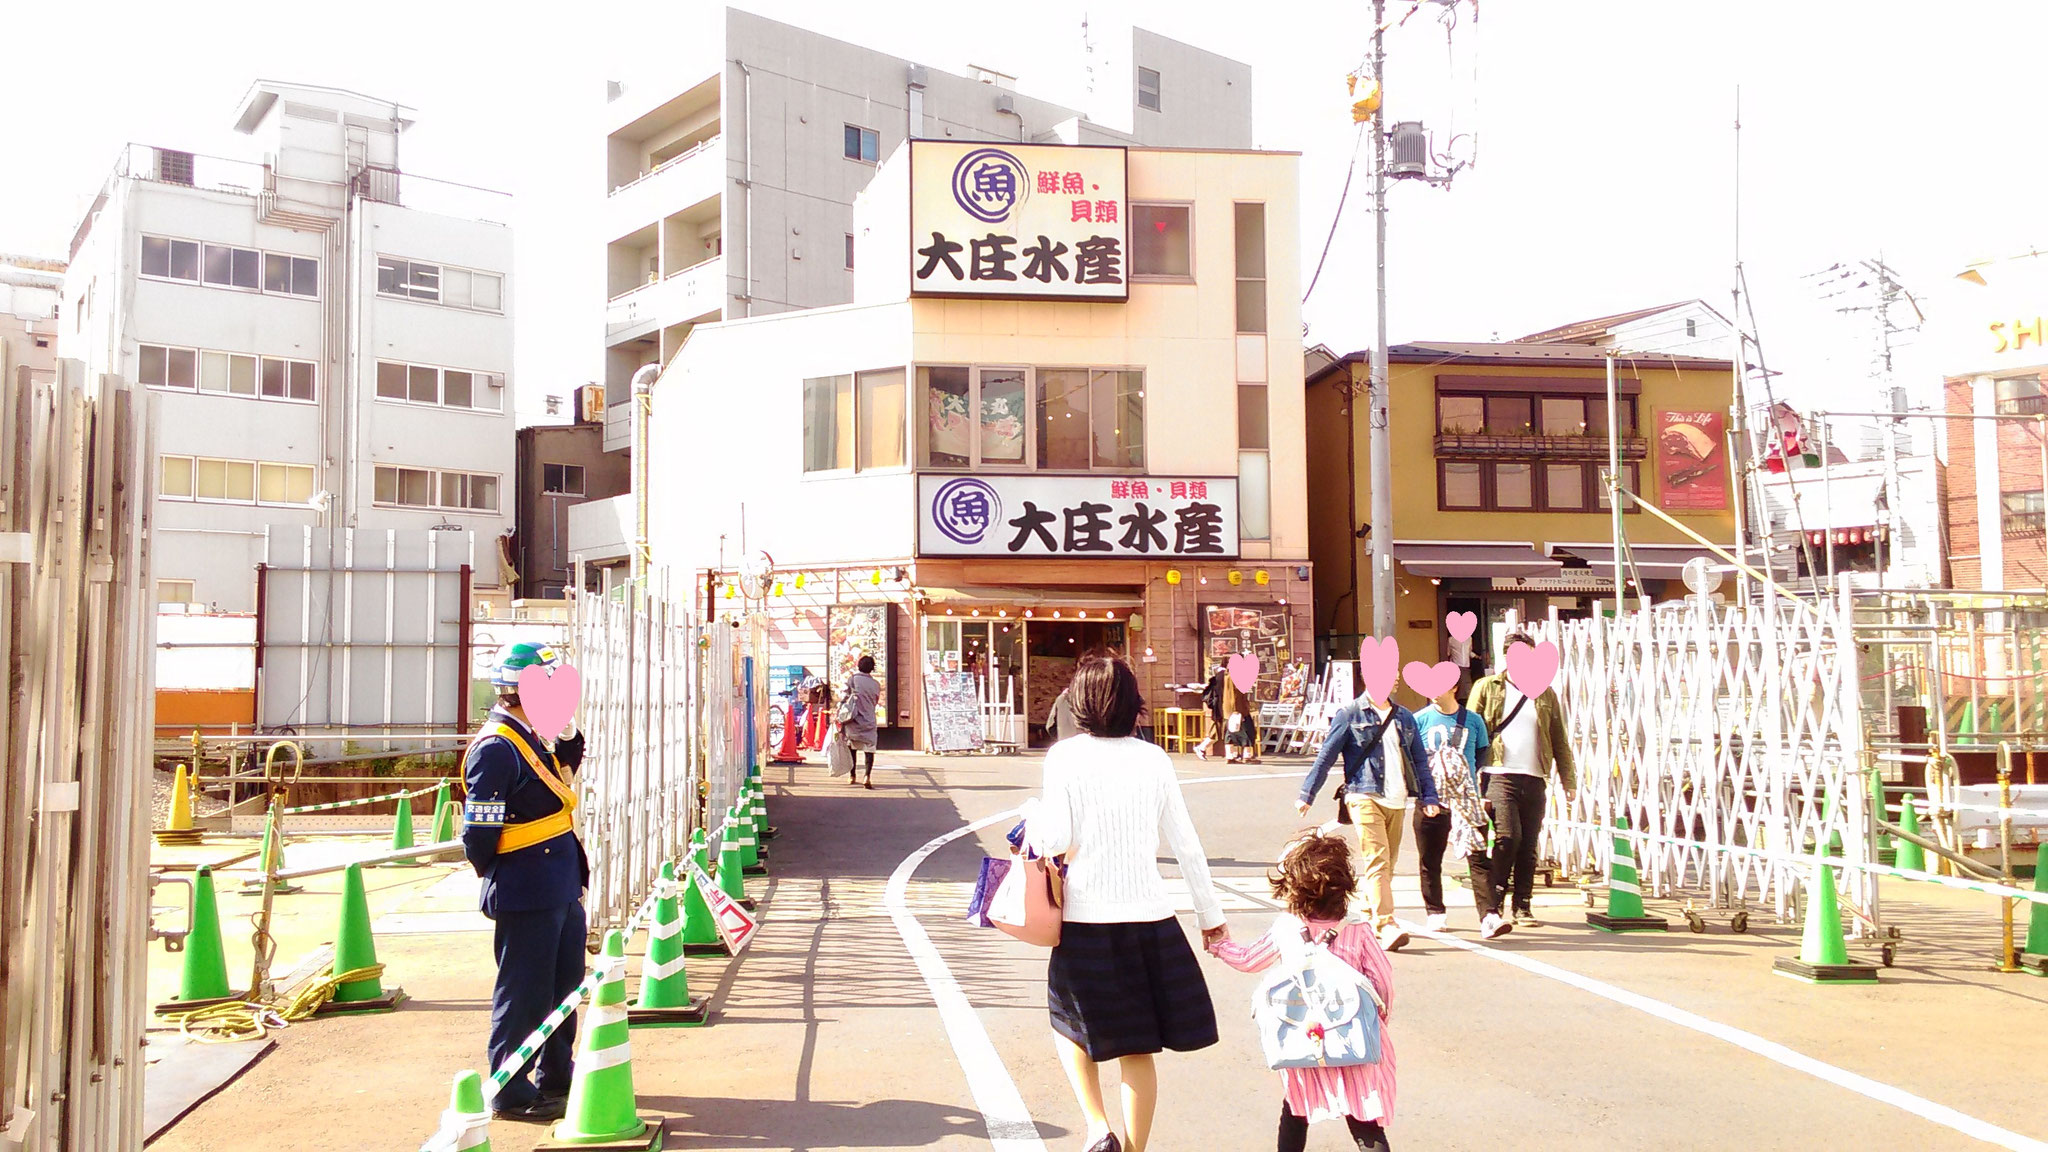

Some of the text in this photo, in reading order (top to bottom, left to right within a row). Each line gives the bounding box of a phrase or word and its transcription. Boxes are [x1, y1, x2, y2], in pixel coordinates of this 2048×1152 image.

[1070, 200, 1118, 224] 貝類
[916, 231, 1124, 285] 大庄水産
[1988, 316, 2048, 354] SH
[1664, 411, 1713, 426] This is Life
[1110, 479, 1208, 500] 鮮魚・貝類
[1007, 501, 1225, 554] 大庄水産
[868, 625, 879, 673] 大庄水
